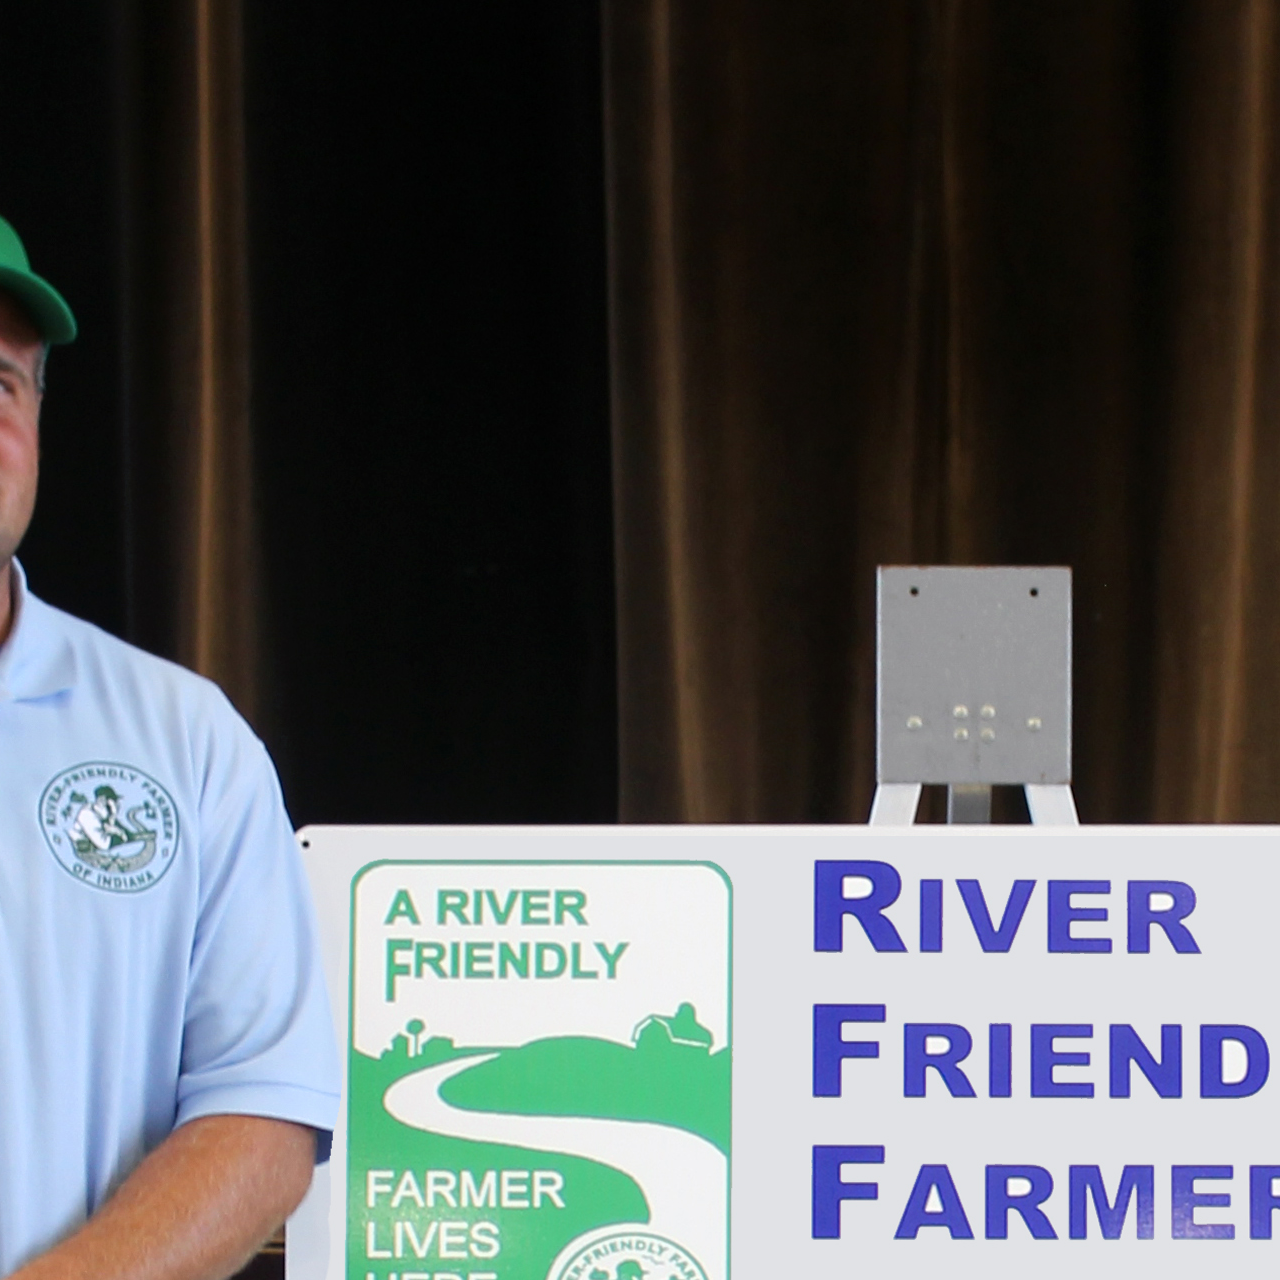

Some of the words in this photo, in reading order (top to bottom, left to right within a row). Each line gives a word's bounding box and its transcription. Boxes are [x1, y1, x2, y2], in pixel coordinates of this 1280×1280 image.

[73, 862, 93, 880] OF
[97, 870, 155, 888] INDIANA
[385, 890, 420, 925] A
[437, 890, 588, 925] RIVER
[813, 860, 1201, 954] RIVER
[386, 939, 629, 1001] FRIENDLY
[366, 1169, 566, 1210] FARMER
[365, 1221, 501, 1260] LIVES
